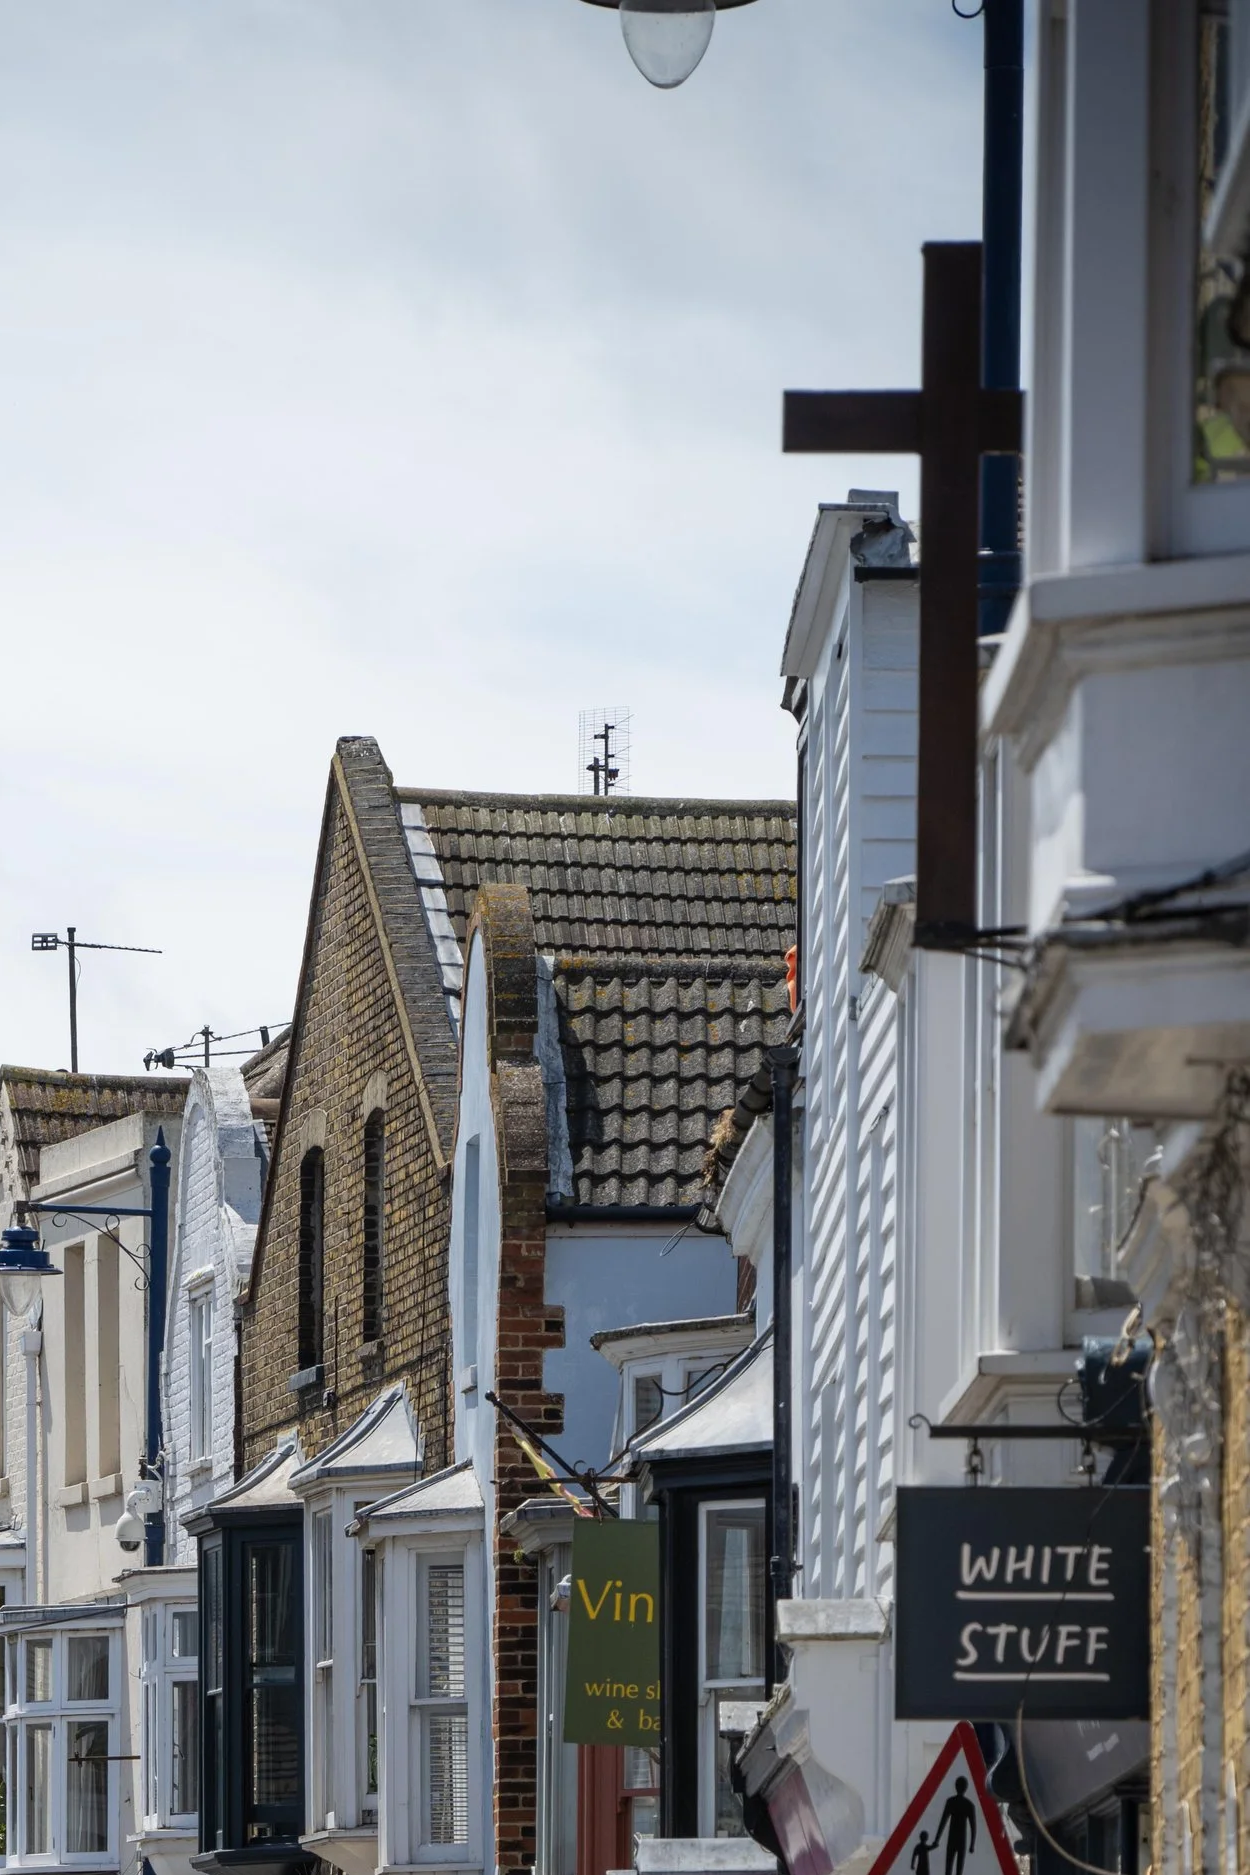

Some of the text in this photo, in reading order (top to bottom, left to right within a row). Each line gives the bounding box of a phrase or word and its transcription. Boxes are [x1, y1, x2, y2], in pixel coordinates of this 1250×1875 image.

[960, 1542, 1113, 1586] WHITE
[576, 1578, 655, 1623] Vin
[955, 1622, 1110, 1666] STUFF
[584, 1678, 639, 1699] wine
[607, 1709, 624, 1729] &
